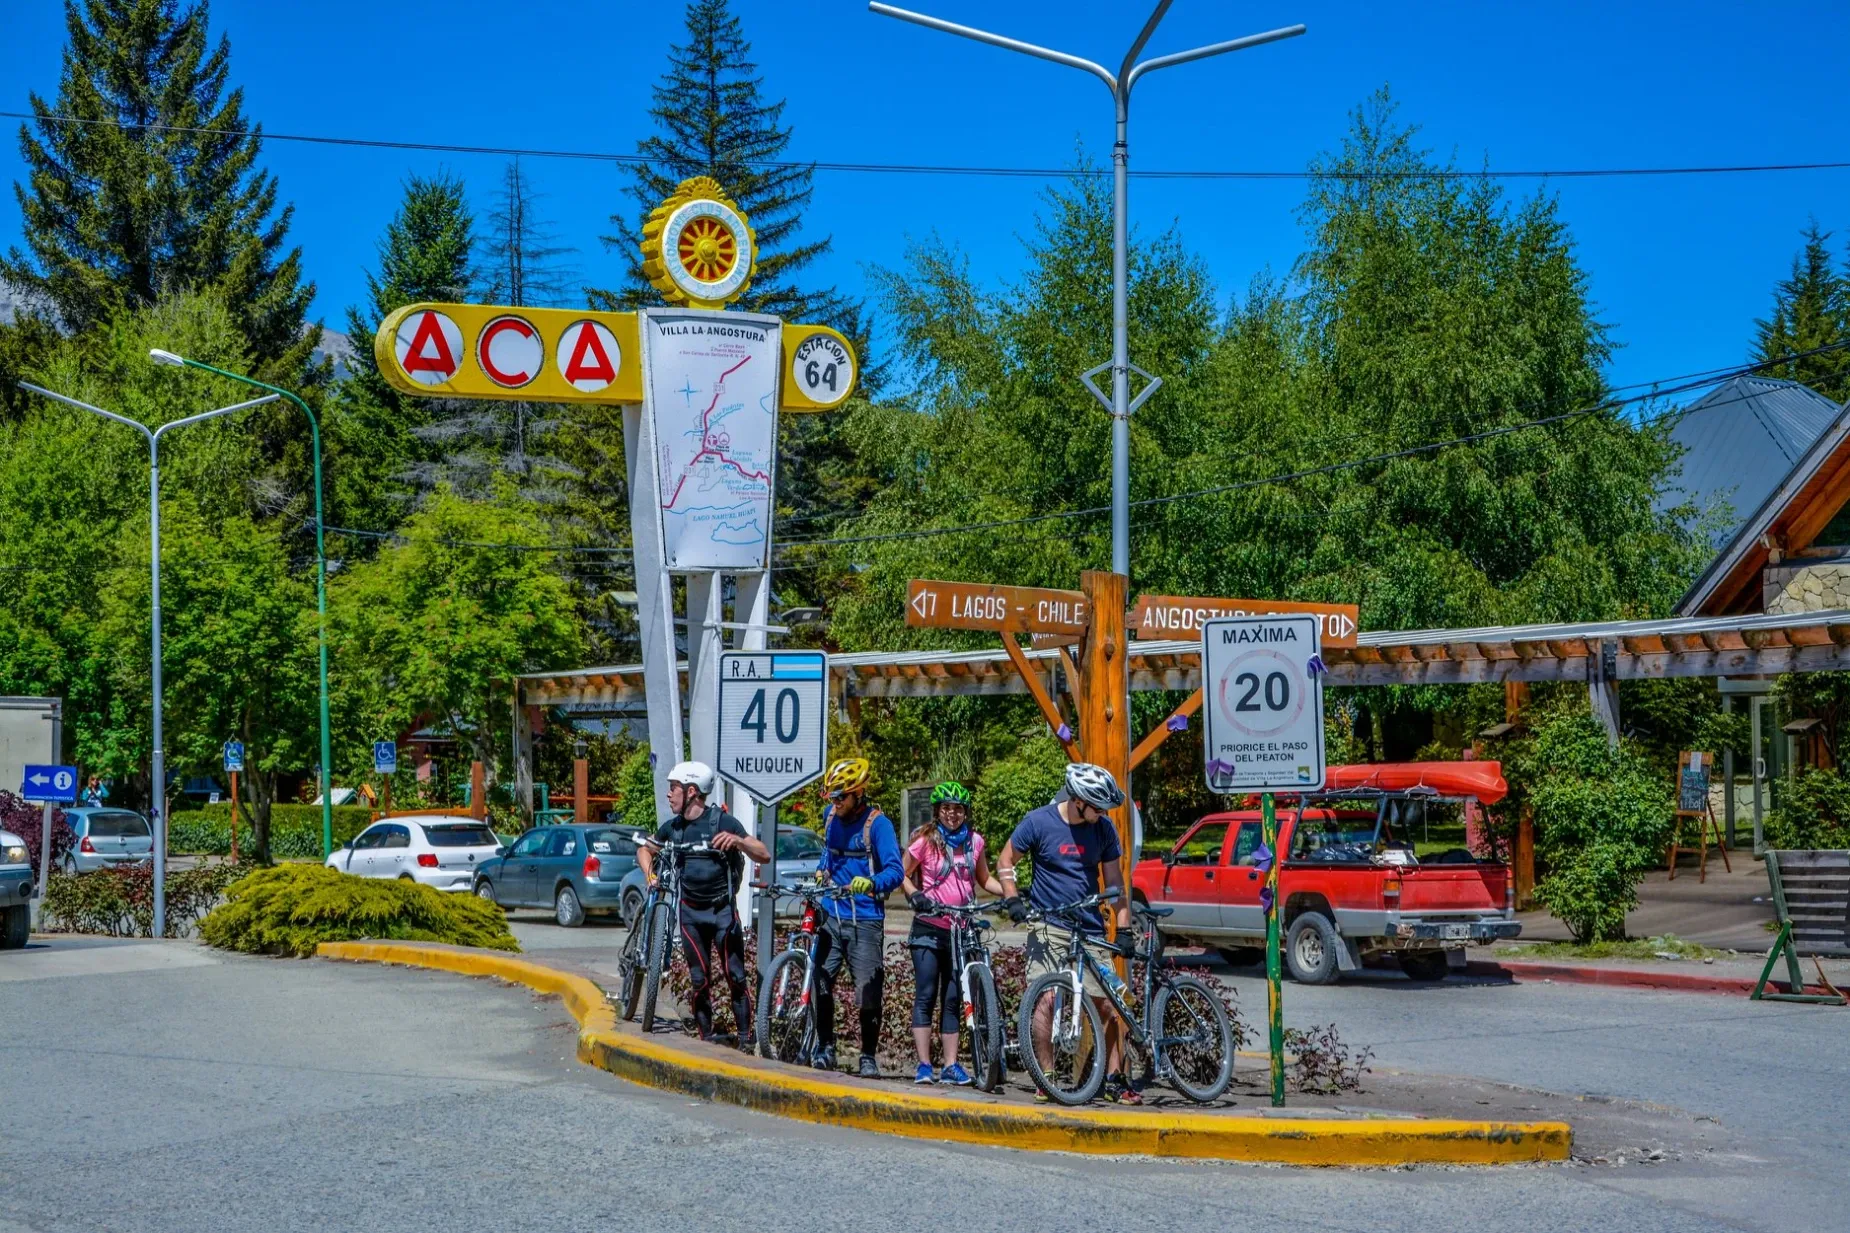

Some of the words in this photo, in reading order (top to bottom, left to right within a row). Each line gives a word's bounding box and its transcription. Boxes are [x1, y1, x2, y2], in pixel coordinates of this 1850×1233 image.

[660, 325, 689, 337] VILLA
[692, 326, 704, 335] LA
[707, 327, 765, 342] ANGOSTURA
[402, 311, 616, 386] ACA
[797, 337, 847, 366] ESTACION
[805, 360, 837, 392] 64
[927, 593, 937, 616] 7
[952, 594, 1007, 620] LAGOS
[1038, 600, 1084, 625] CHILE
[1143, 606, 1256, 631] ANGOS
[1223, 627, 1297, 644] MAXIMA
[732, 660, 761, 678] R.A.
[1235, 671, 1290, 712] 20
[740, 687, 800, 744] 40
[1220, 743, 1266, 752] PRIORICE
[1268, 742, 1280, 751] EL
[1282, 741, 1308, 750] PASO
[1235, 754, 1254, 763] DEL
[1256, 753, 1294, 762] PEATON
[735, 757, 803, 773] NEUQUEN
